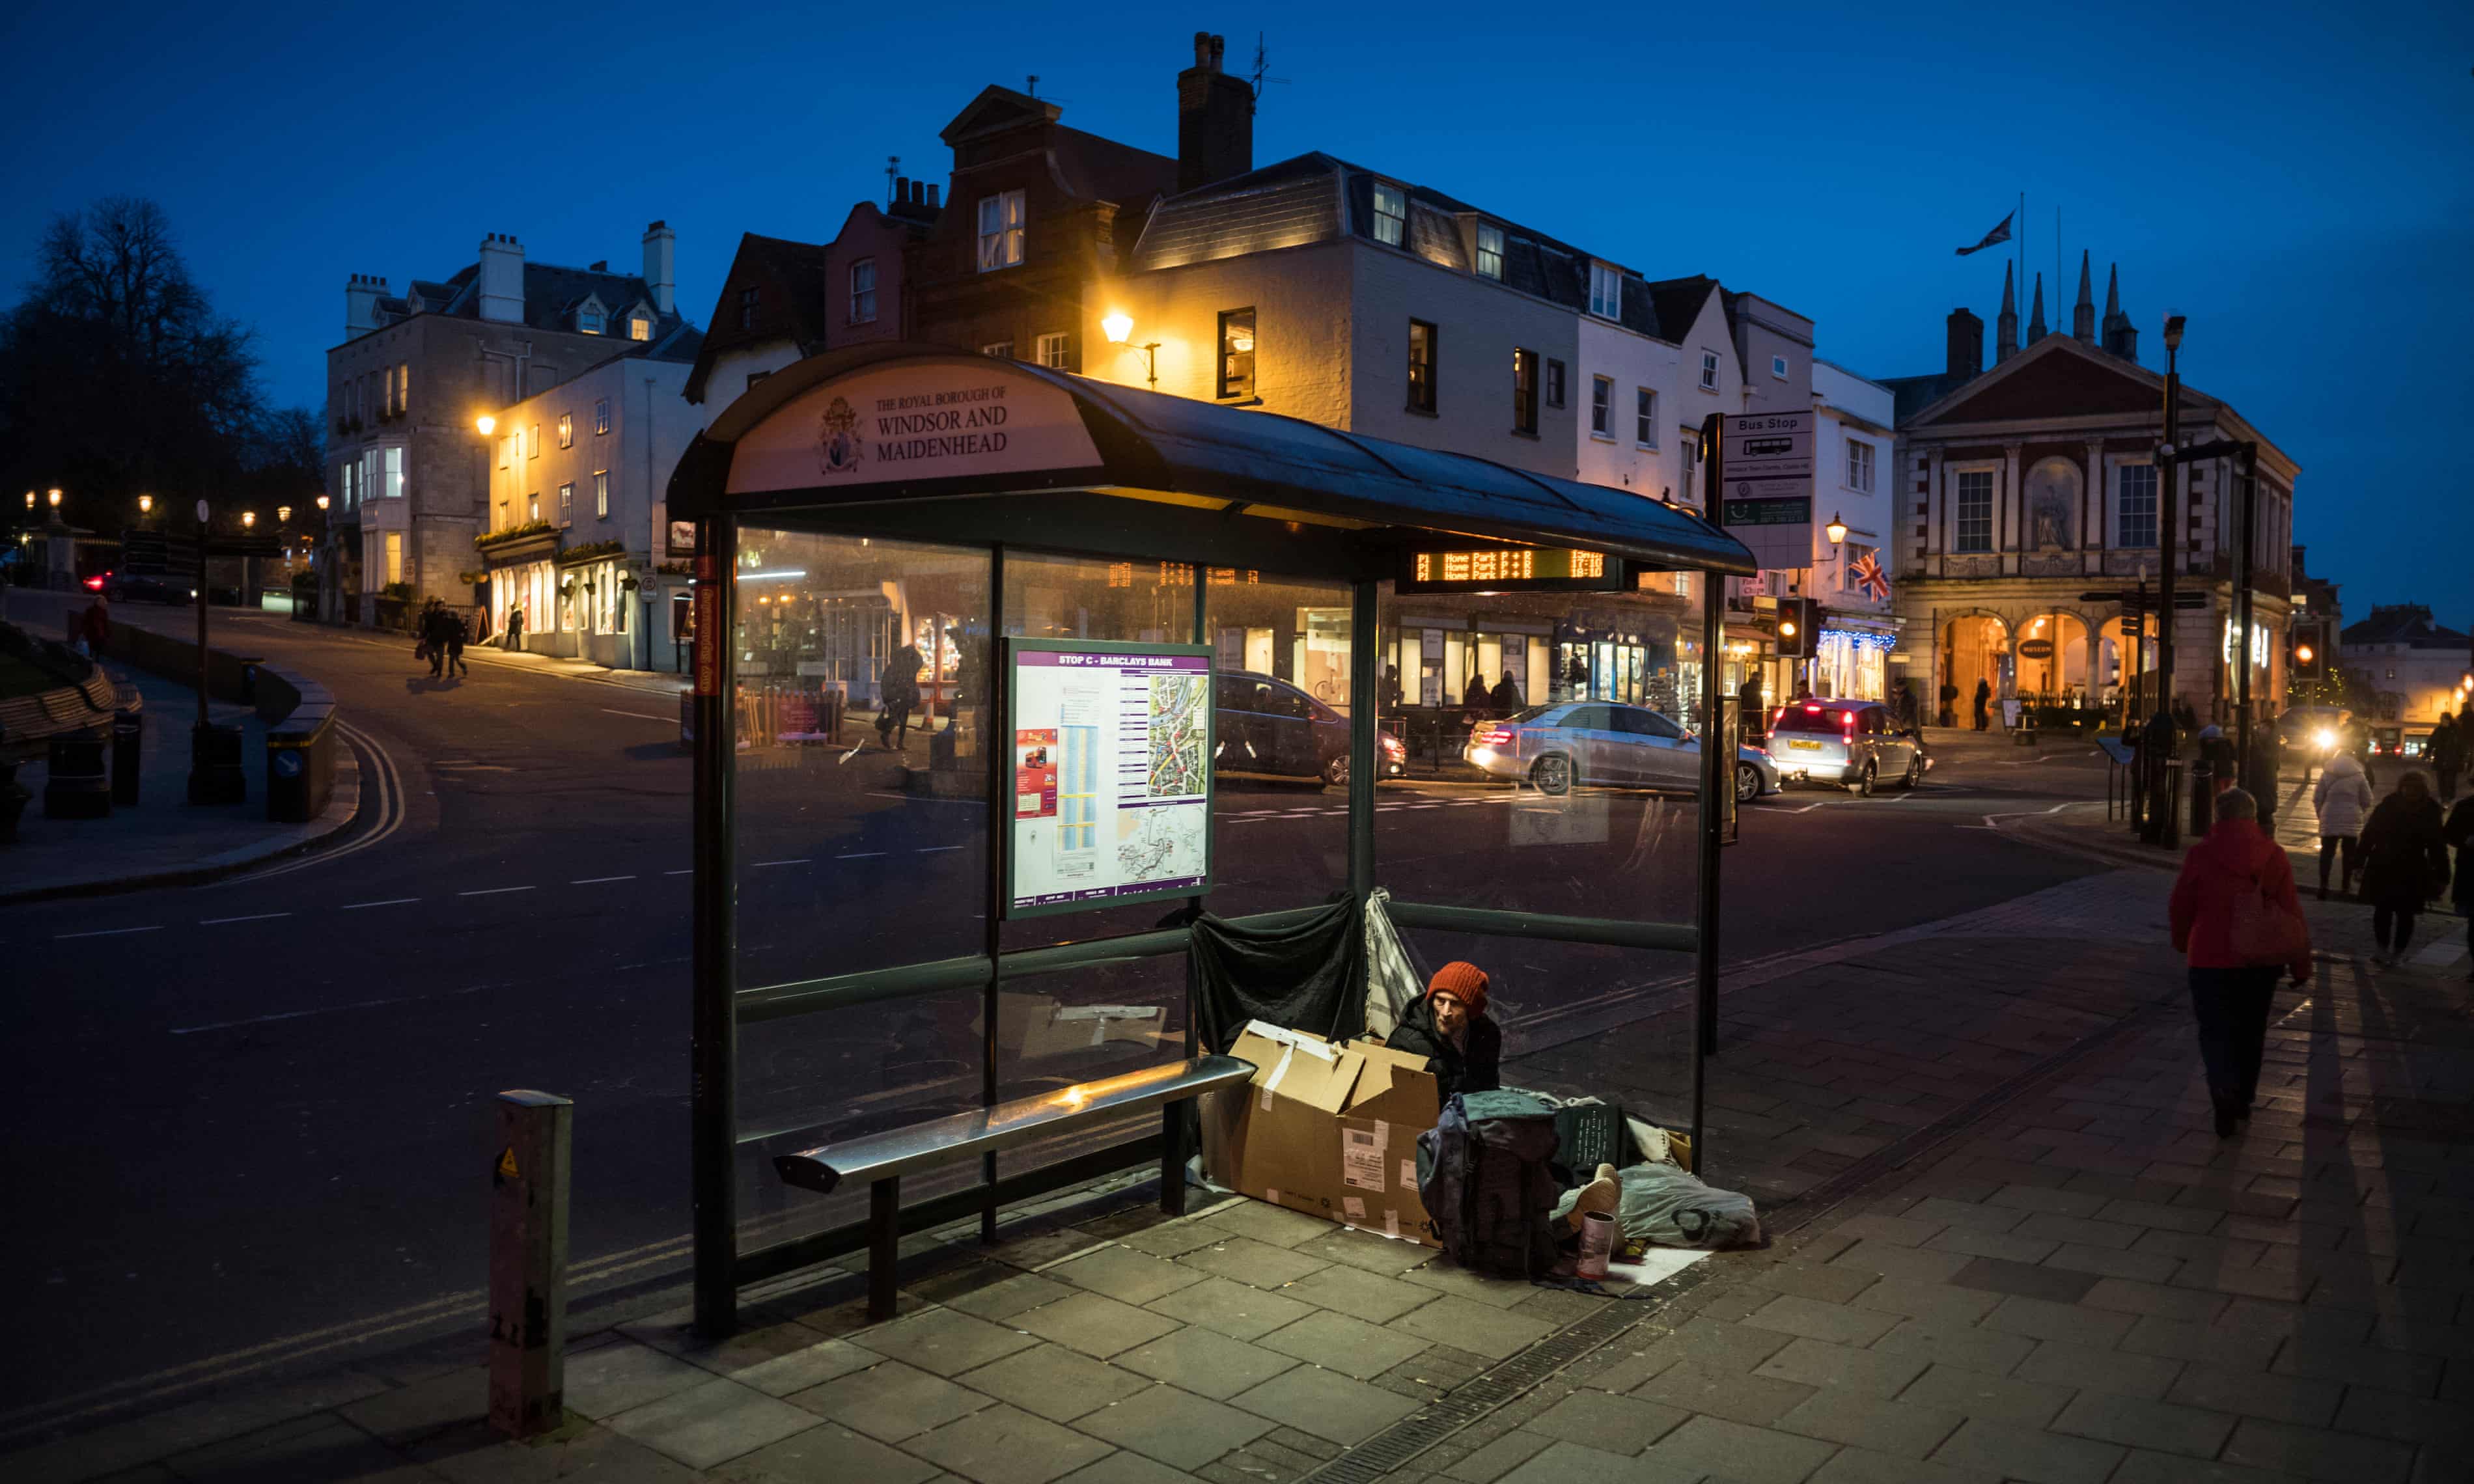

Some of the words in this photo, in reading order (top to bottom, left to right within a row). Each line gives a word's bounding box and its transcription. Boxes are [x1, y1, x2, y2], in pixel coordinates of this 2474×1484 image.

[876, 400, 896, 412] THE
[898, 394, 933, 409] ROYAL
[936, 387, 990, 405] BOROUGH
[992, 385, 1006, 398] OF
[878, 410, 960, 436] WINDSOR
[966, 405, 1007, 428] AND
[1739, 420, 1762, 430] Bus
[1768, 418, 1798, 429] Stop
[877, 432, 1007, 462] MAIDENHEAD
[1418, 554, 1429, 563] P1
[1445, 553, 1469, 562] Home
[1473, 552, 1496, 562] Park
[1501, 551, 1508, 560] P
[1523, 551, 1531, 560] R
[1418, 562, 1429, 571] P1
[1445, 562, 1469, 571] Home
[1473, 561, 1496, 570] Park
[1501, 560, 1508, 570] P
[1523, 560, 1531, 570] R
[1572, 558, 1603, 568] 17:10
[1418, 571, 1429, 581] P1
[1445, 571, 1469, 580] Home
[1473, 570, 1496, 579] Park
[1501, 570, 1508, 579] P
[1523, 570, 1531, 579] R
[1572, 568, 1603, 577] 18:10
[1059, 655, 1084, 665] STOP
[1086, 656, 1093, 665] C
[1100, 656, 1147, 666] BARCLAYS
[1148, 657, 1173, 666] BANK
